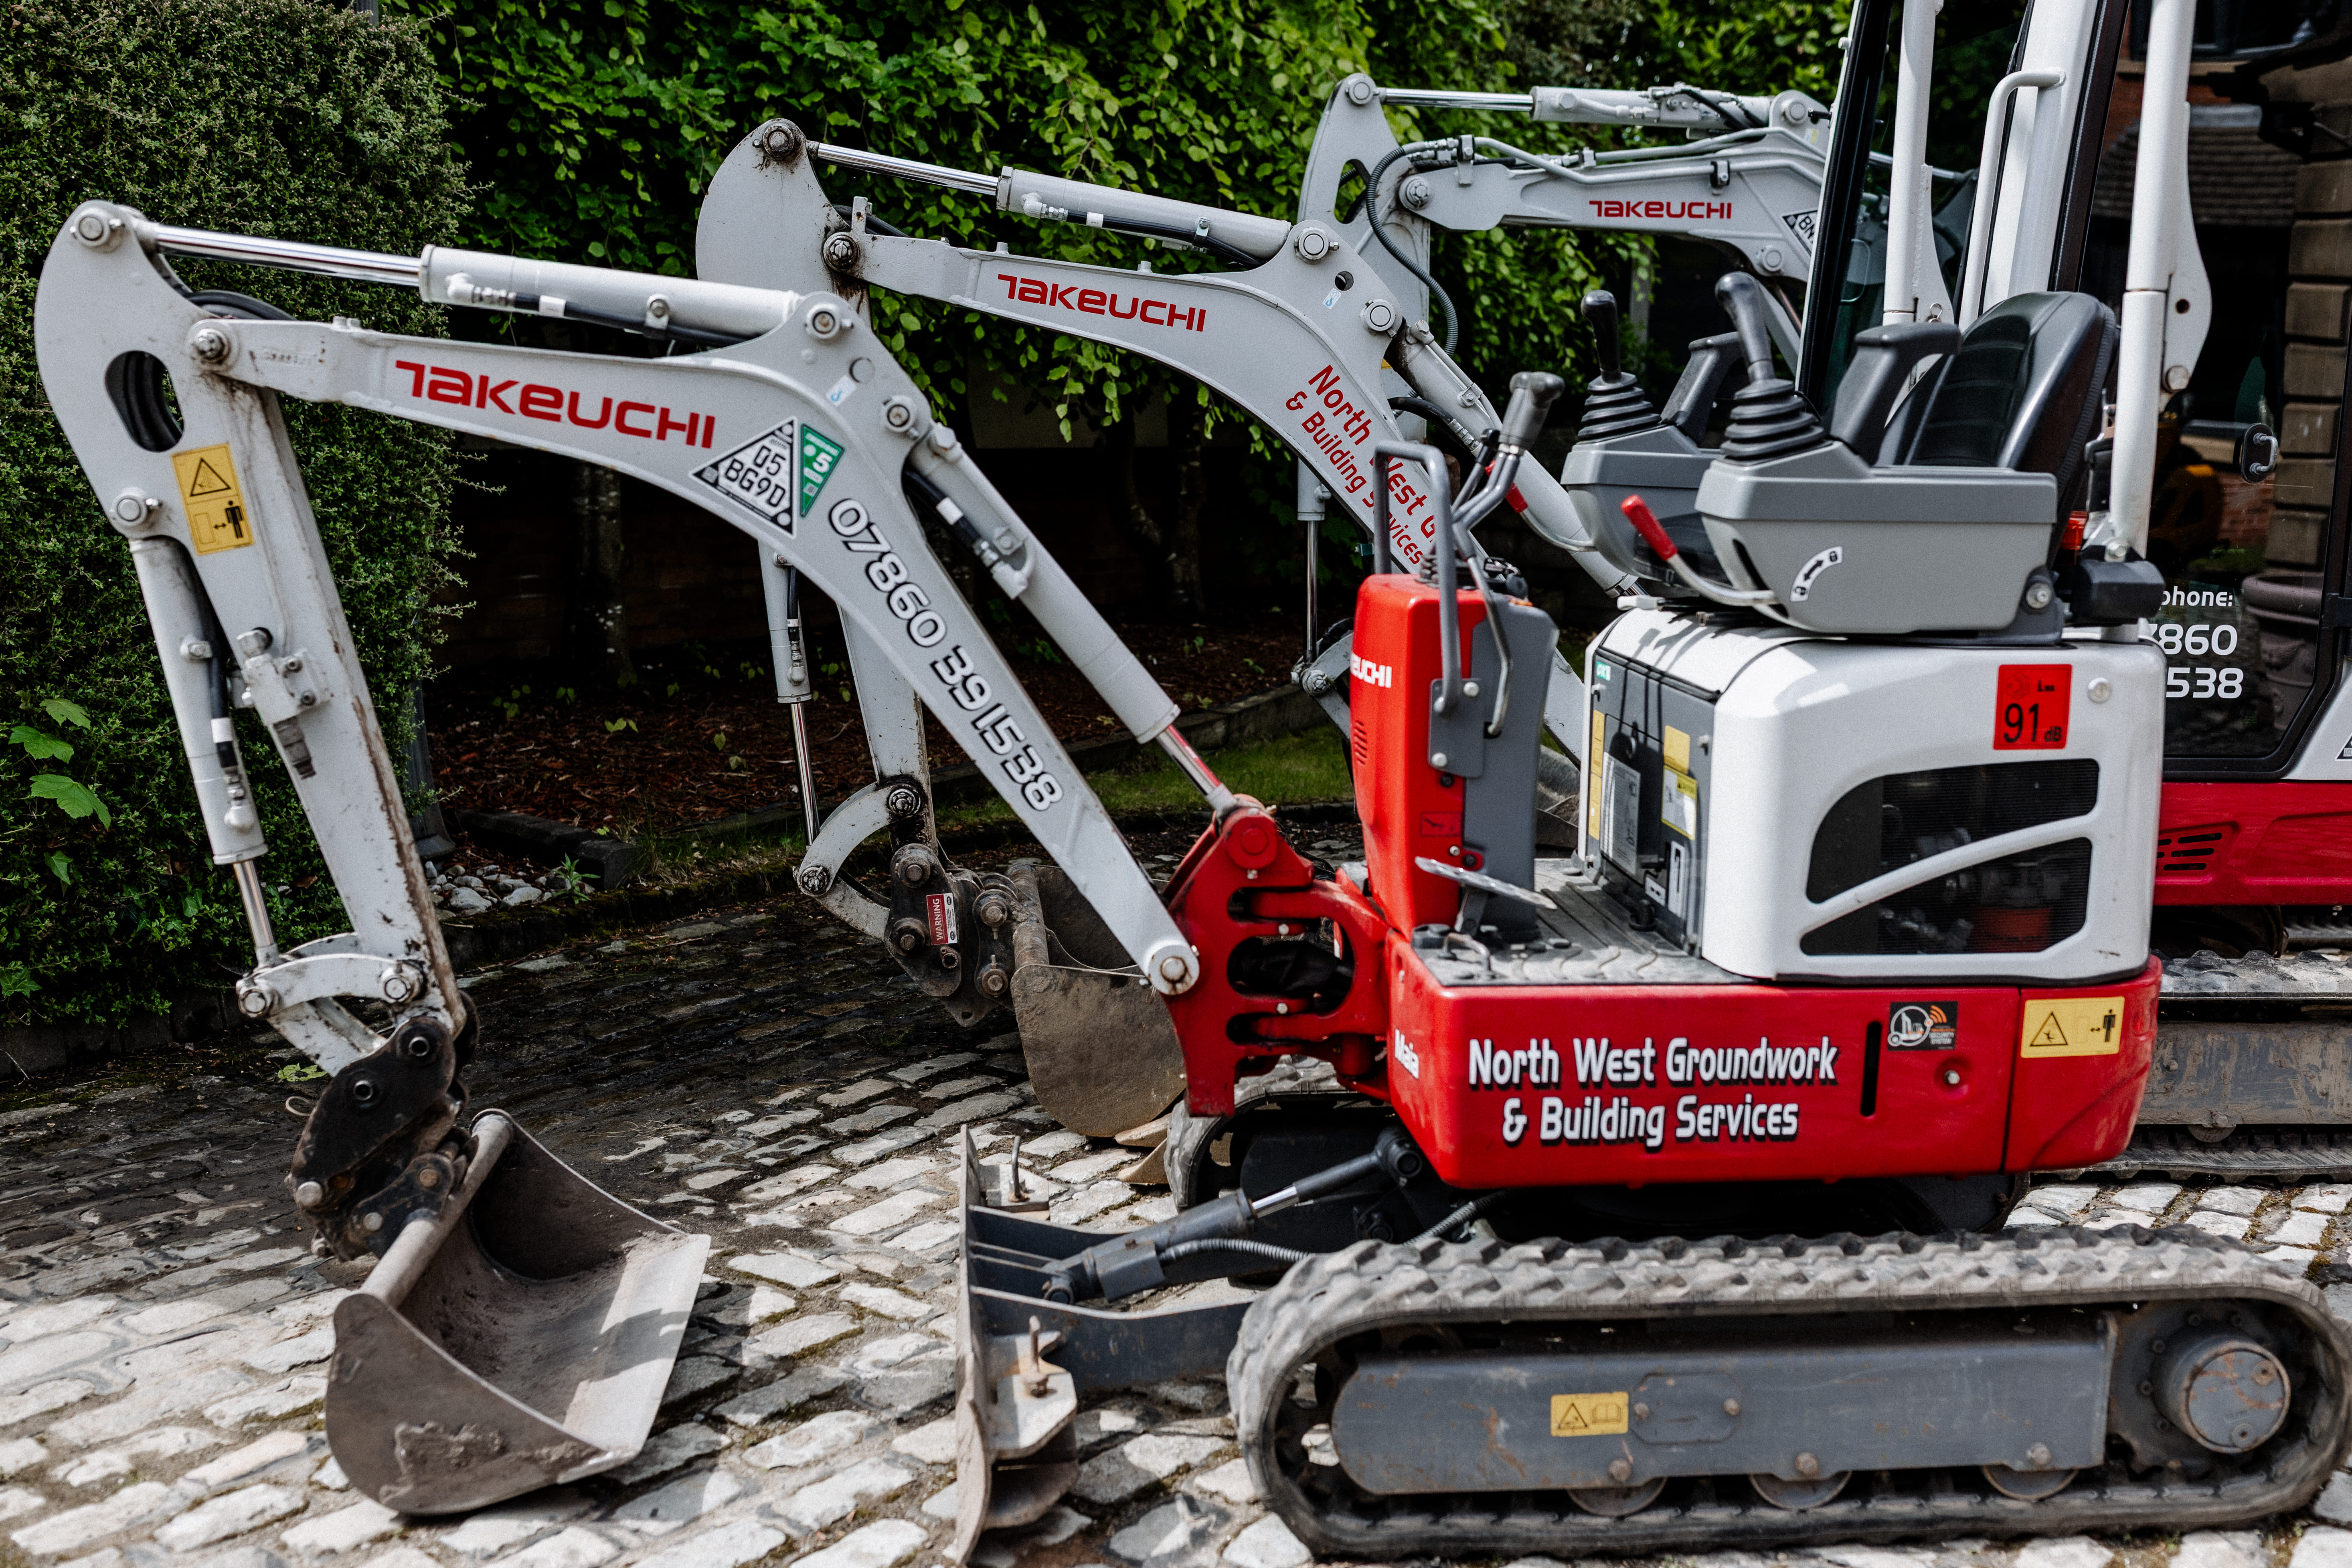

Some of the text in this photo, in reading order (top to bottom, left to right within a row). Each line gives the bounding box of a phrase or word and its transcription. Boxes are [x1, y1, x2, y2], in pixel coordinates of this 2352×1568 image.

[1799, 215, 1815, 243] BN
[1308, 365, 1372, 445] North
[812, 451, 833, 473] 5
[1286, 391, 1308, 411] &
[1301, 411, 1367, 493] Building
[829, 498, 1064, 811] 07860 391538
[2166, 667, 2244, 698] 538
[2004, 703, 2062, 743] 91 dB
[933, 898, 943, 941] WARNING
[1469, 1036, 1839, 1085] North West Groundwork
[1502, 1093, 1799, 1148] & Building Services
